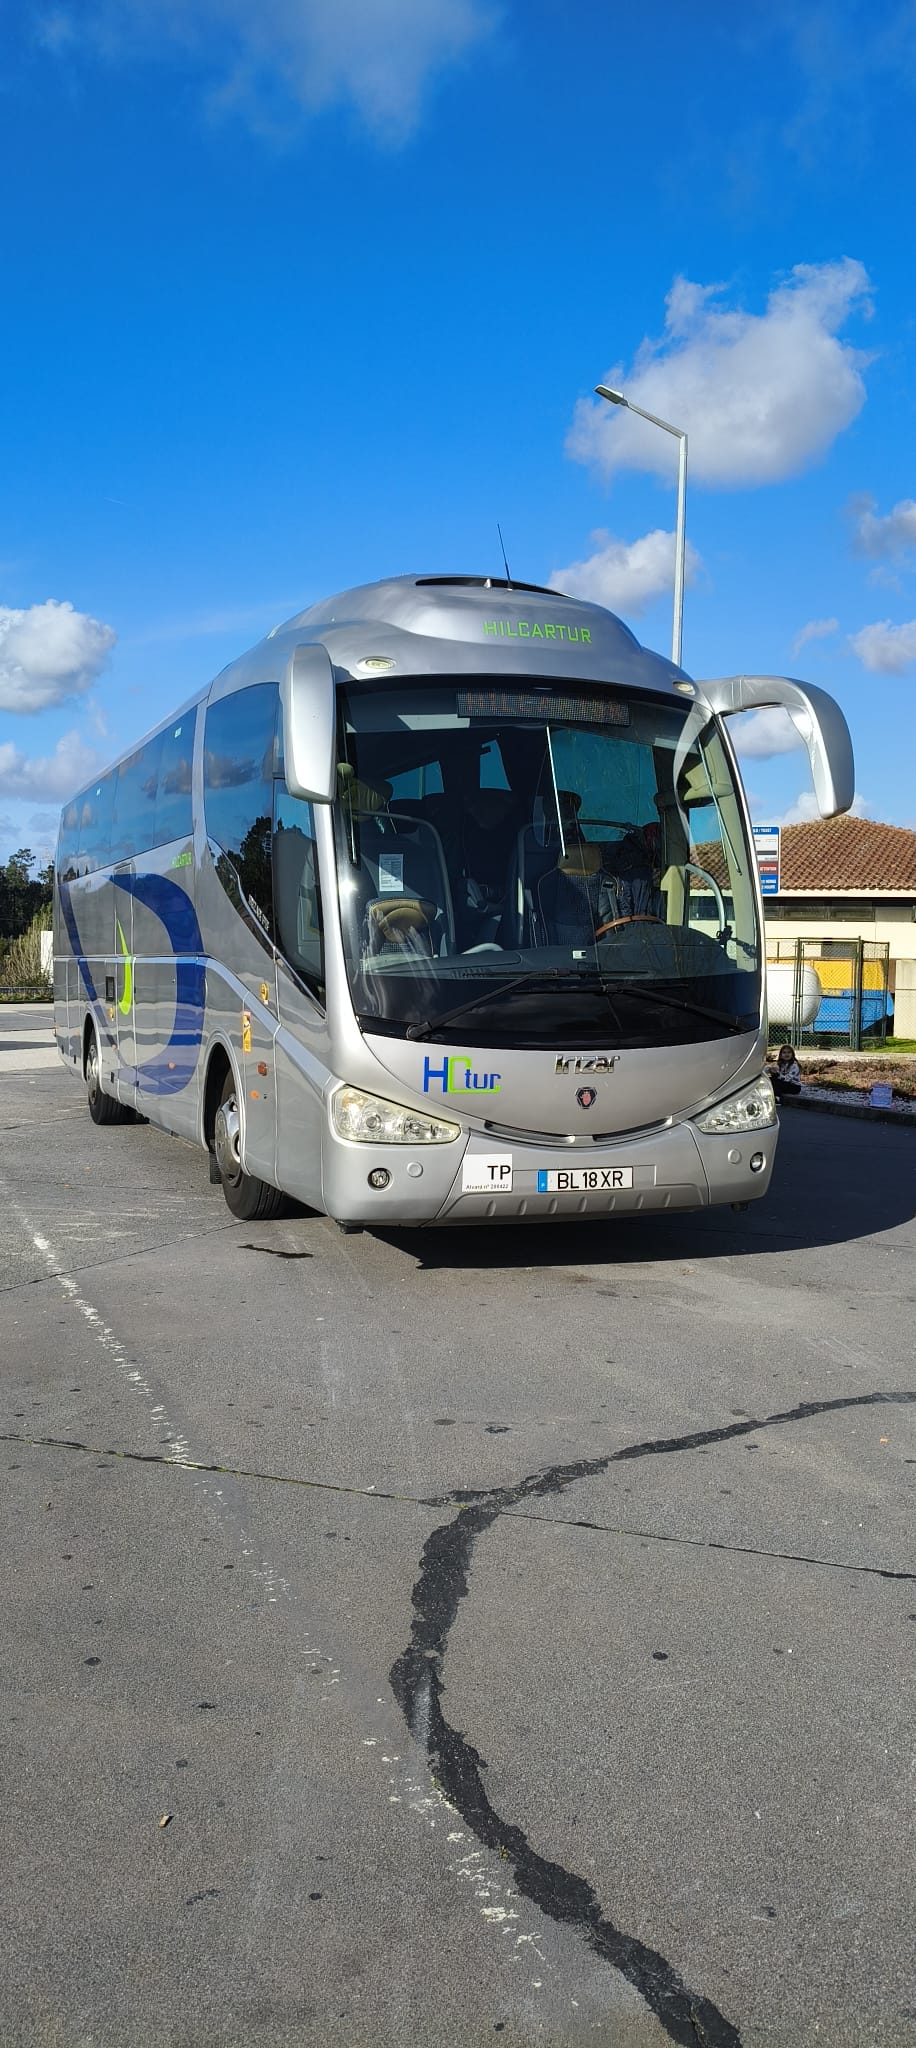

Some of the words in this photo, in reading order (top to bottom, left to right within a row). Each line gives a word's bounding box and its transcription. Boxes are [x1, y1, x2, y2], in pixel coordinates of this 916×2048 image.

[483, 621, 592, 643] HILCARTUR
[487, 1165, 511, 1181] TP
[557, 1172, 579, 1190] BL
[582, 1171, 598, 1188] 18
[600, 1170, 623, 1187] XR
